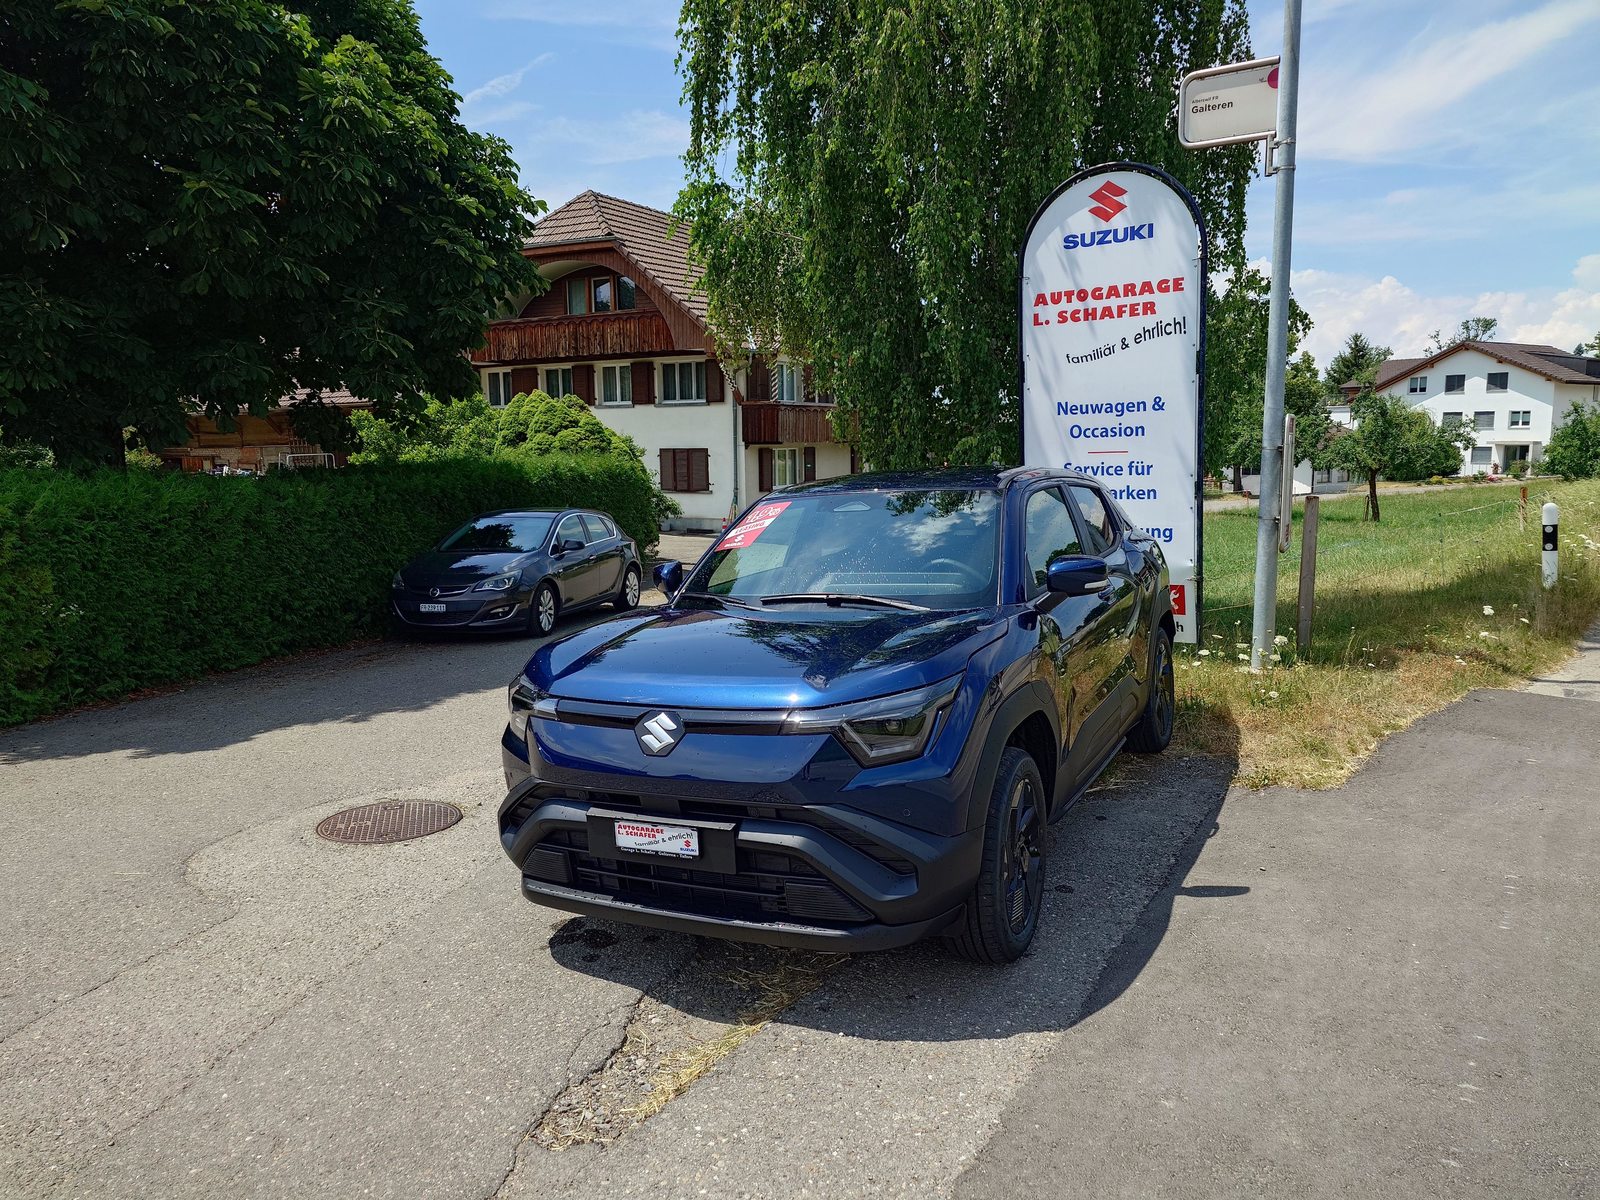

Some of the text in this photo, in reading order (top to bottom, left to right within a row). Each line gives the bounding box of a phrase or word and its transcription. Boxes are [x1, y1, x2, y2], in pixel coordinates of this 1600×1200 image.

[1191, 101, 1233, 114] Galteren
[1063, 223, 1154, 250] SUZUKI
[1033, 277, 1185, 307] AUTOGARAGE
[1033, 301, 1157, 326] L. SCHAFER
[1066, 316, 1187, 364] familiär & ehrlich!
[1057, 396, 1165, 417] Neuwagen &
[1069, 423, 1145, 439] Occasion
[1063, 461, 1153, 476] Service für
[1111, 485, 1157, 500] arken
[617, 824, 665, 834] AUTOGARAGE
[625, 830, 657, 839] SCHAFER
[667, 832, 694, 842] ehrlich!
